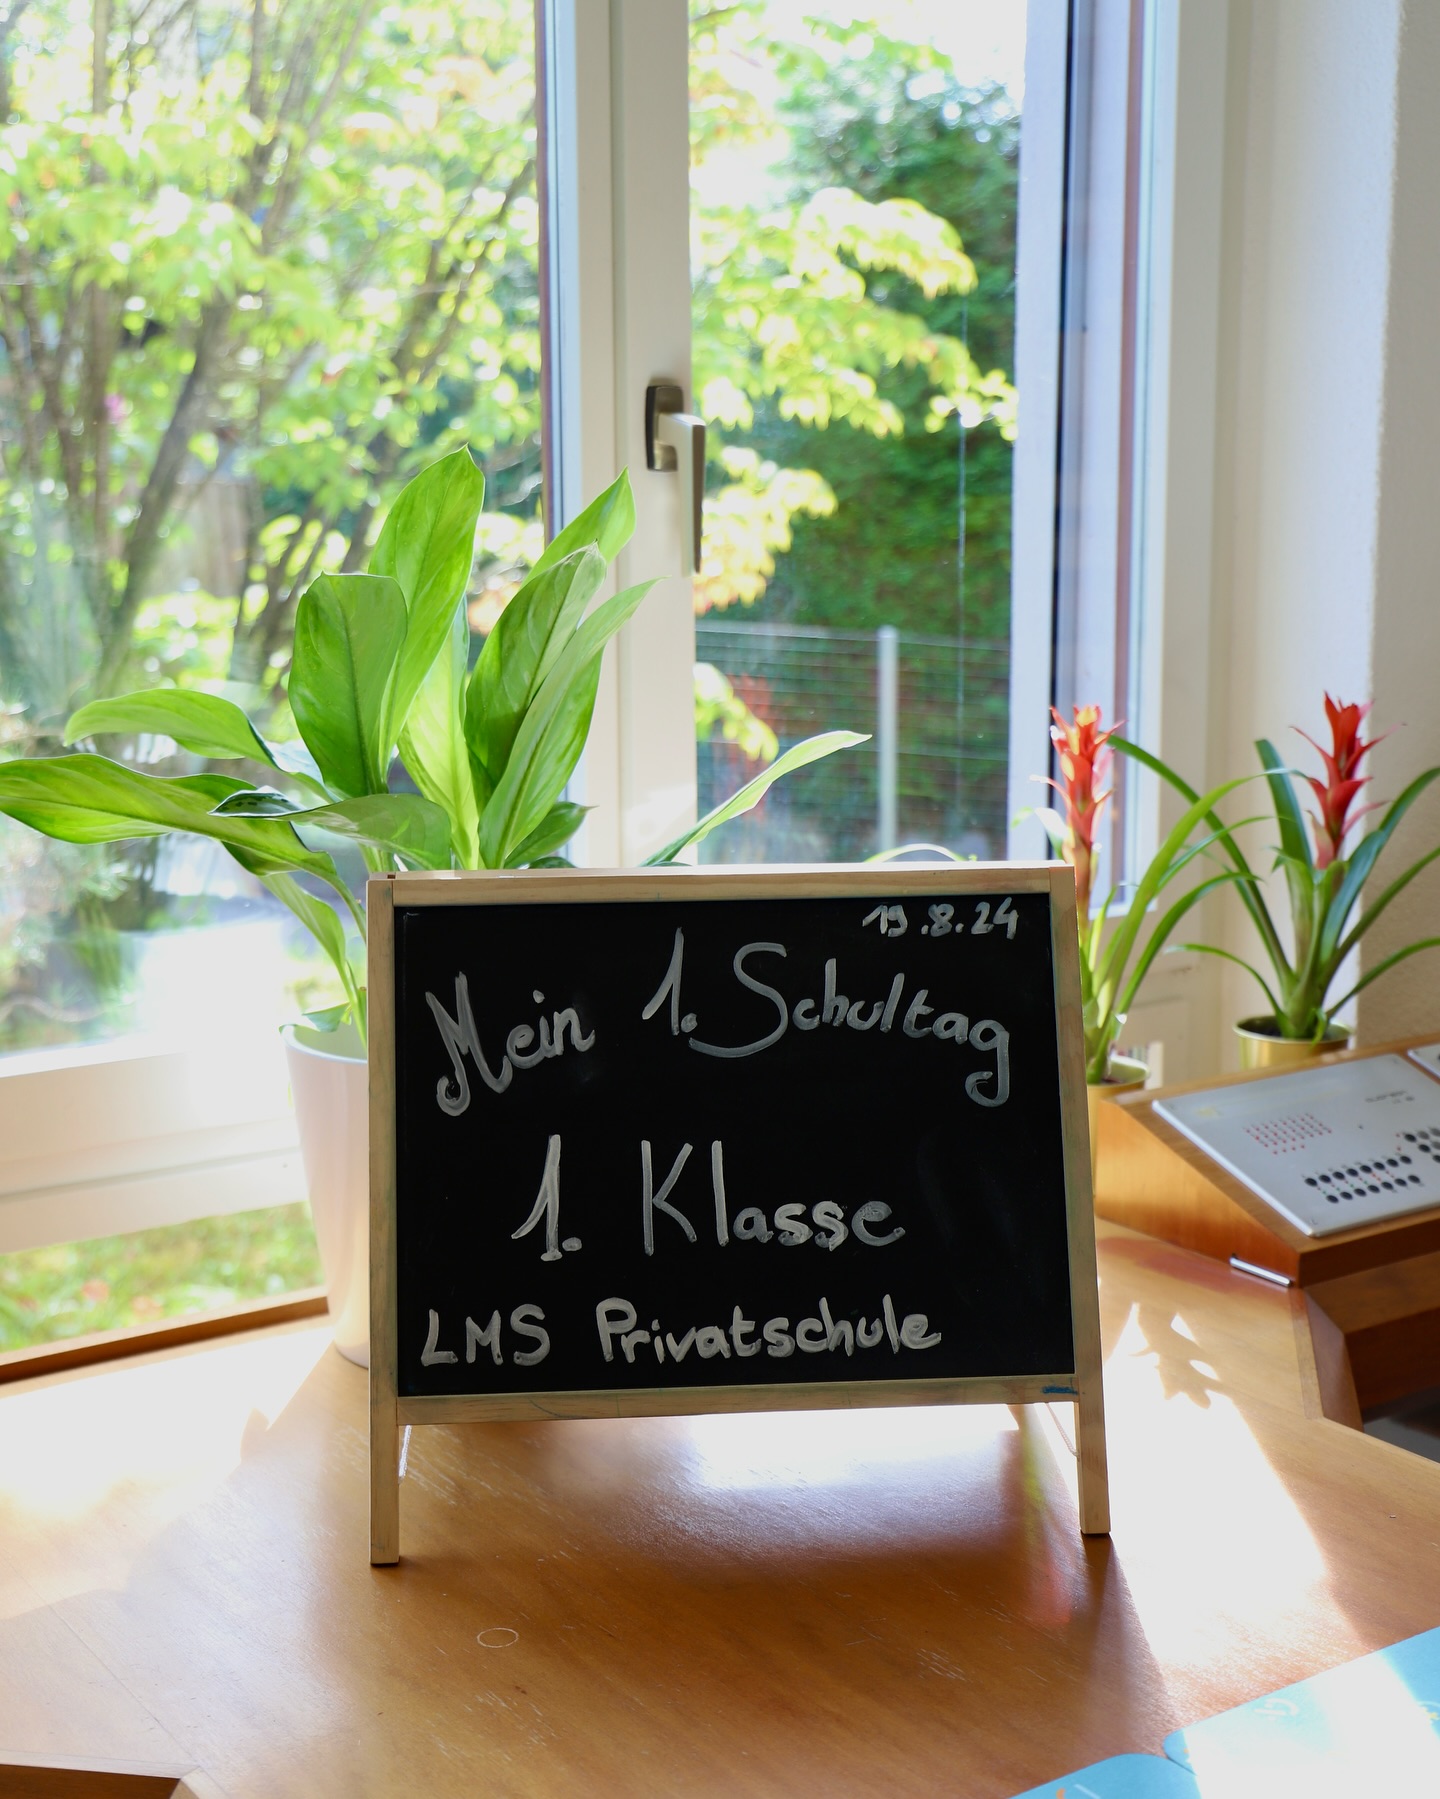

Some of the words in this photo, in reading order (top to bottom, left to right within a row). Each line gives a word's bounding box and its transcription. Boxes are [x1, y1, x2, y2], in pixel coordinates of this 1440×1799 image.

[425, 971, 596, 1117] Mein
[641, 926, 699, 1036] 1.
[688, 941, 1011, 1107] Schultag
[510, 1134, 583, 1262] 1.
[640, 1139, 907, 1257] Klasse
[420, 1303, 552, 1367] LMS
[595, 1293, 943, 1364] Privatschule
